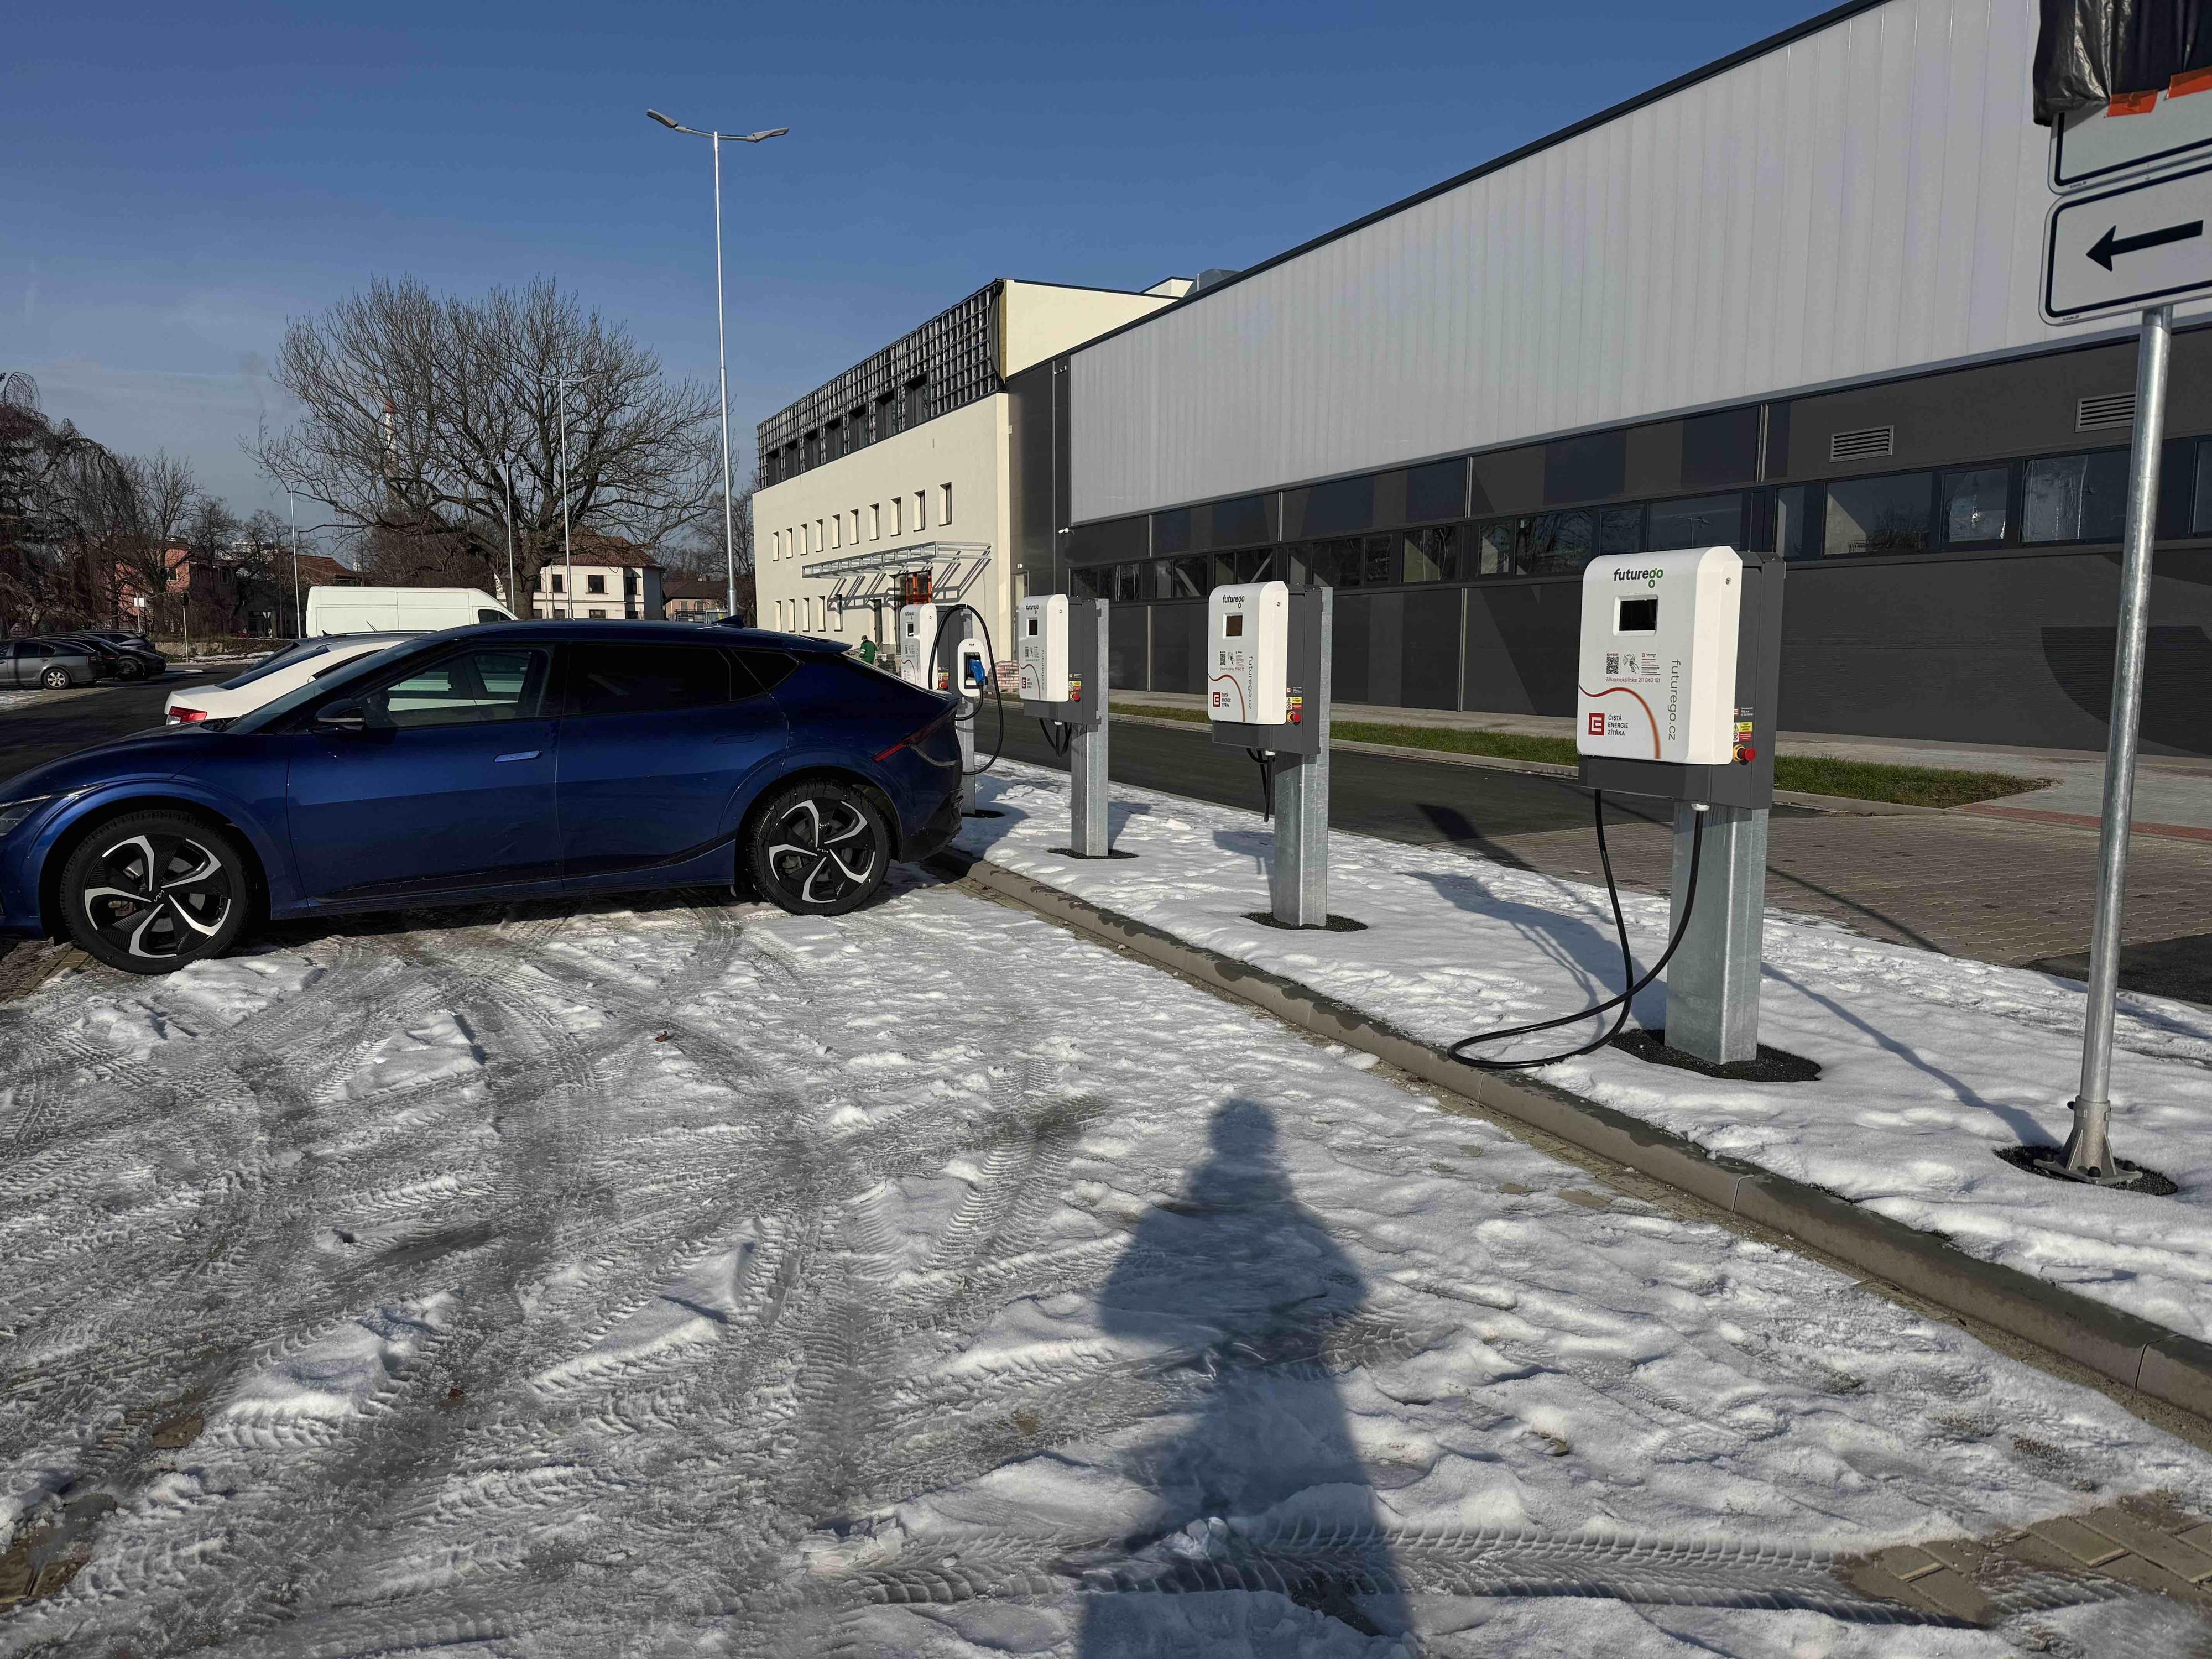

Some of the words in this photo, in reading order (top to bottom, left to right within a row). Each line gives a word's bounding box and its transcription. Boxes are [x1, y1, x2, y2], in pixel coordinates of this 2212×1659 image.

[1614, 568, 1663, 588] futurego
[1222, 594, 1245, 609] futurego
[1667, 659, 1681, 741] futurego.cz
